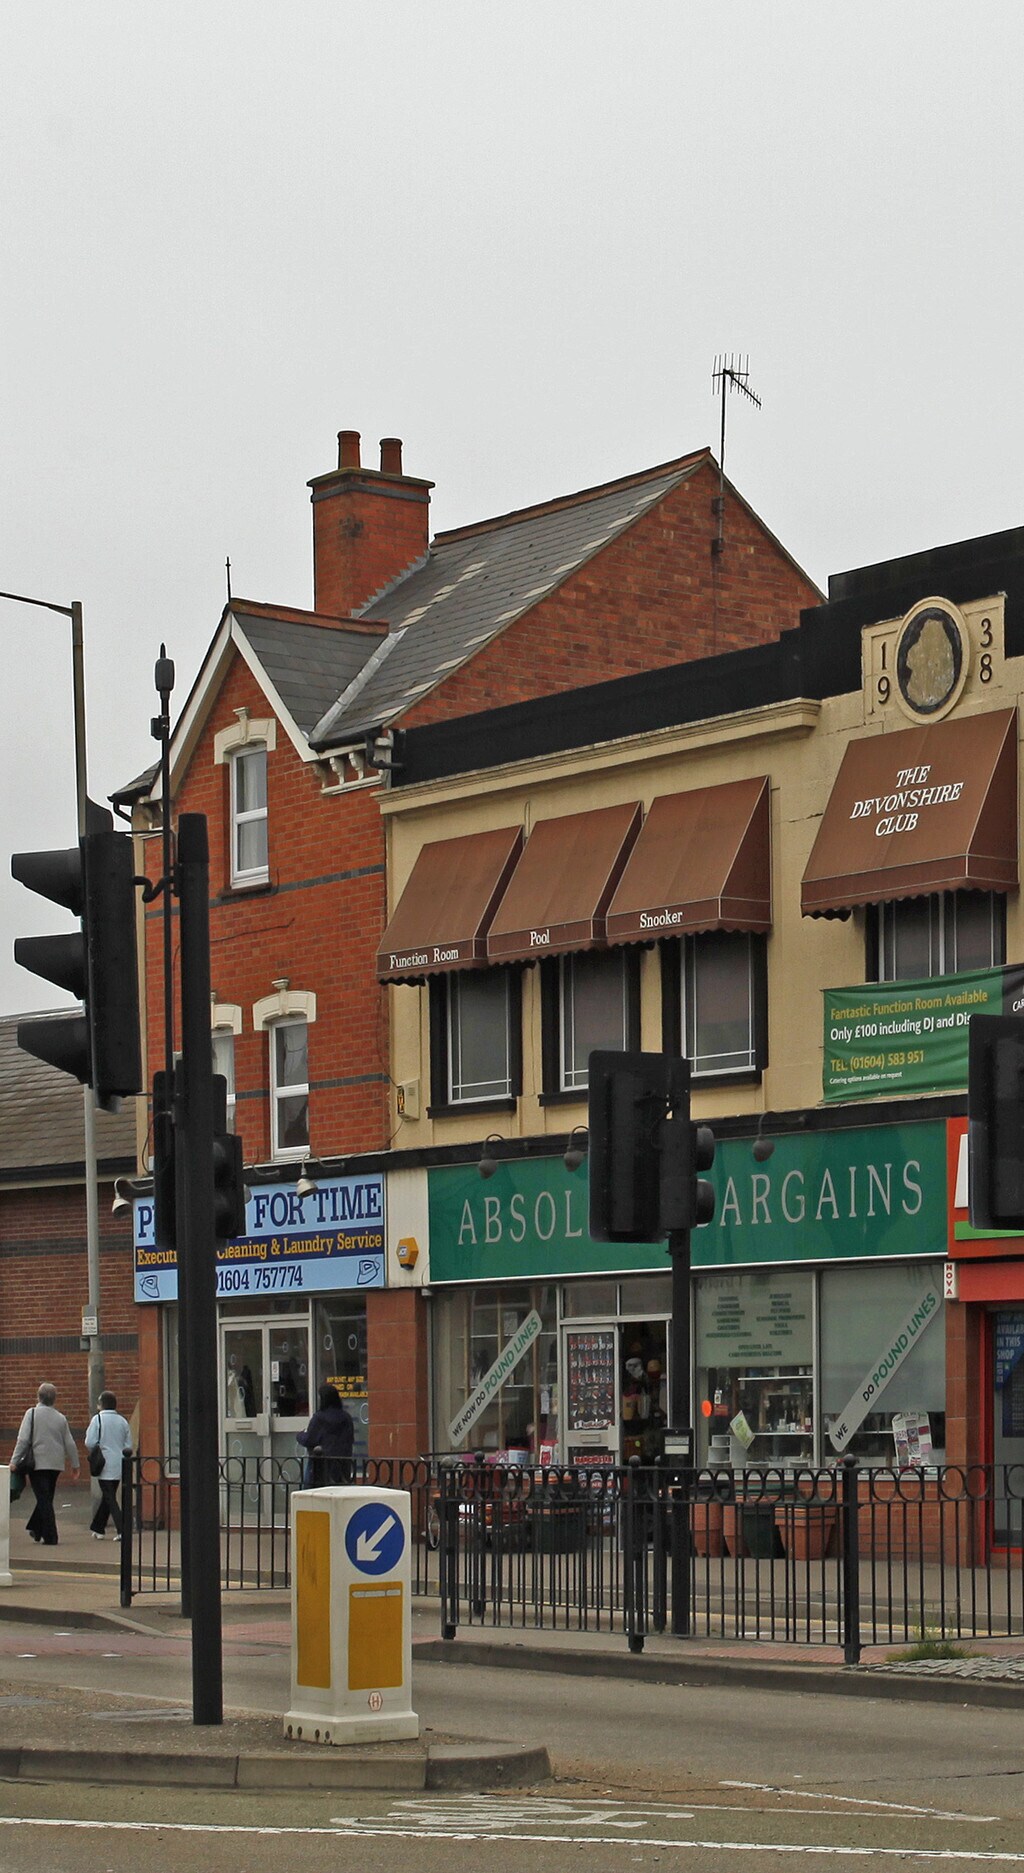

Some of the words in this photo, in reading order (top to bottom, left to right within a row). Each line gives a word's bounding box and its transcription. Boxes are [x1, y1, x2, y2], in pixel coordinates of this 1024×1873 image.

[896, 765, 931, 788] THE
[850, 782, 963, 819] DEVONSHIRE
[874, 813, 919, 837] CLUB
[639, 909, 683, 929] Snooker
[529, 929, 550, 947] Pool
[389, 952, 428, 970] Function
[433, 947, 459, 962] Room
[830, 1003, 872, 1021] Fantastic
[873, 1001, 913, 1016] Function
[915, 997, 943, 1010] Room
[945, 989, 989, 1006] Available
[830, 1027, 853, 1044] Only
[854, 1023, 878, 1039] £100
[879, 1018, 922, 1036] including
[923, 1017, 935, 1033] DJ
[936, 1013, 955, 1029] and
[849, 1053, 886, 1073] (01604)
[887, 1051, 906, 1066] 583
[907, 1049, 925, 1065] 951
[253, 1190, 306, 1229] FOR
[312, 1182, 382, 1224] TIME
[696, 1159, 925, 1230] ARGAINS
[270, 1236, 281, 1255] &
[283, 1233, 334, 1259] Laundry
[336, 1231, 383, 1251] Service
[253, 1264, 303, 1289] 757774
[945, 1263, 954, 1296] NOVA
[996, 1337, 1004, 1347] IN
[1005, 1335, 1021, 1347] THIS
[835, 1423, 849, 1441] WE
[862, 1384, 875, 1402] DO
[871, 1333, 909, 1388] POUND
[906, 1292, 936, 1337] LINES
[996, 1349, 1015, 1360] SHOP
[451, 1422, 464, 1437] WE
[461, 1402, 478, 1425] NOW
[475, 1391, 487, 1407] DO
[484, 1350, 515, 1395] POUND
[513, 1316, 539, 1354] LINES
